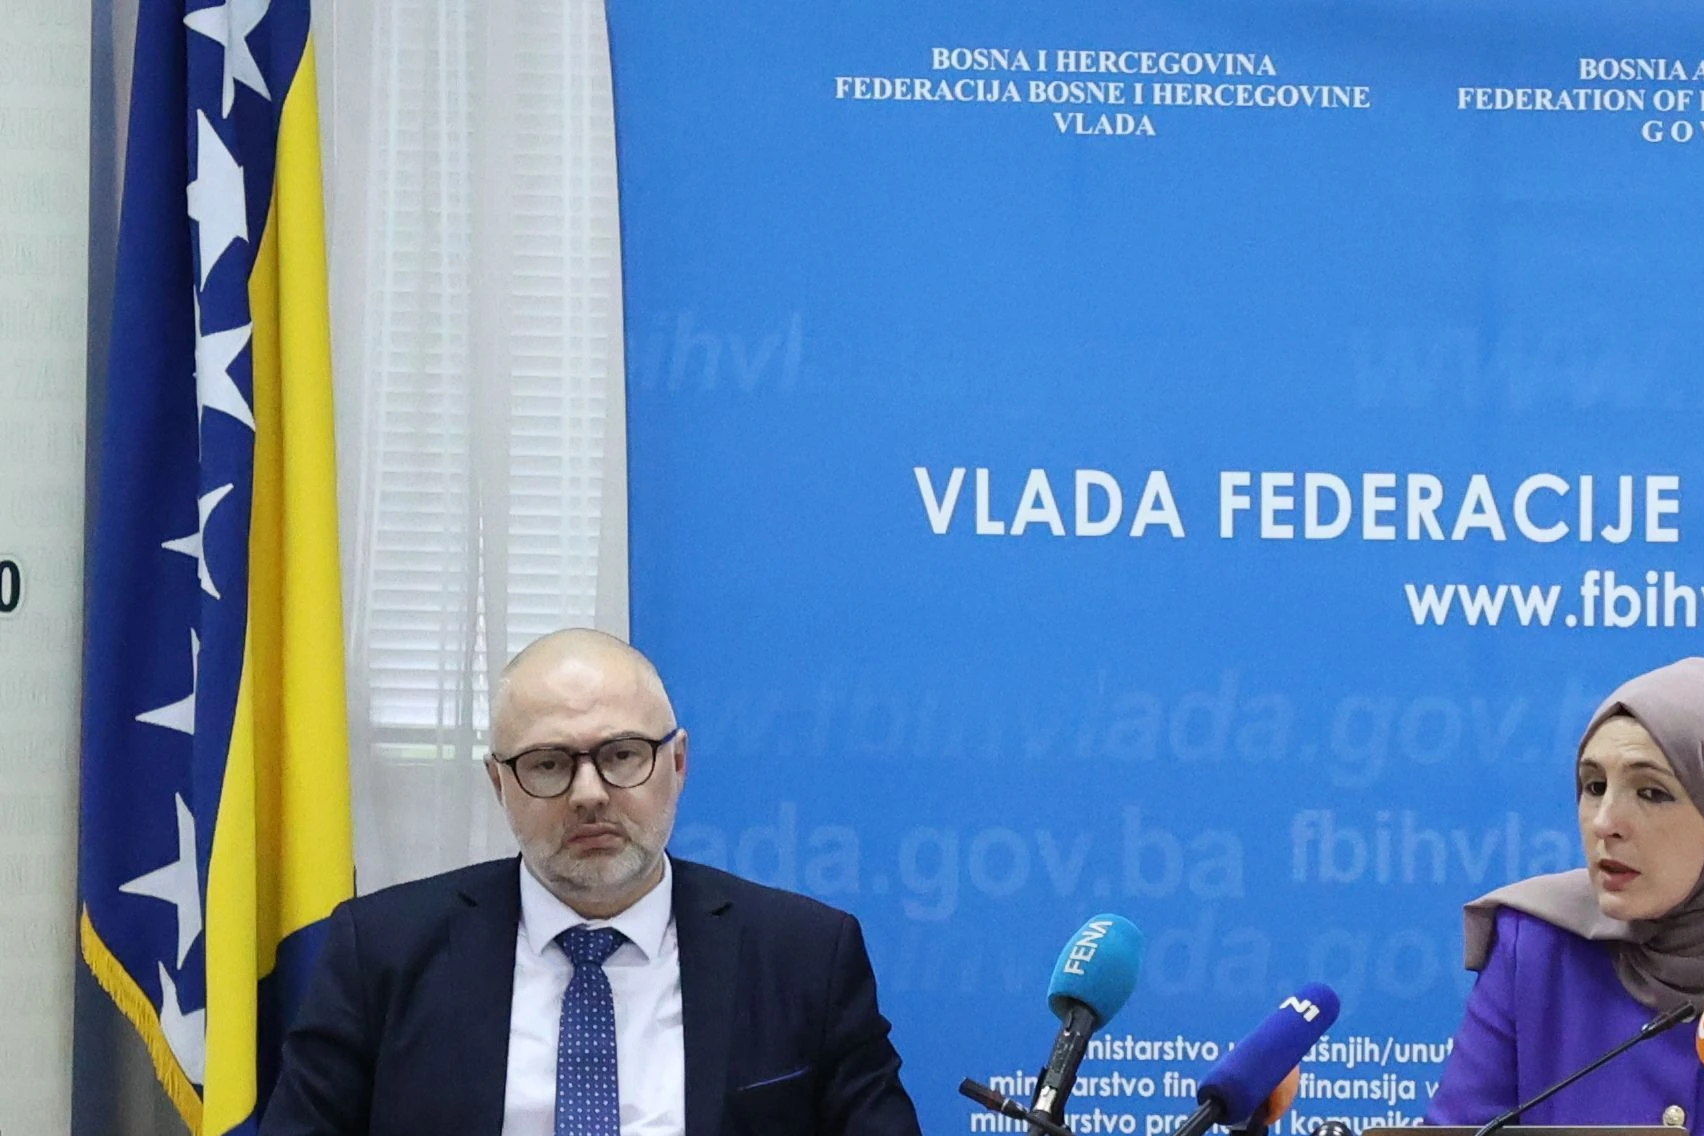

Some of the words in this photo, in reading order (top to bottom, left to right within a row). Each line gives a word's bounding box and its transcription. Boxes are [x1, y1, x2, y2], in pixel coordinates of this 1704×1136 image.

[933, 48, 1030, 71] BOSNA
[1038, 50, 1046, 71] I
[1057, 50, 1276, 75] HERCEGOVINA
[1580, 59, 1688, 80] BOSNIA
[836, 77, 1021, 101] FEDERACIJA
[1029, 81, 1124, 104] BOSNE
[1134, 83, 1143, 104] I
[1153, 83, 1370, 107] HERCEGOVINE
[1459, 88, 1645, 110] FEDERATION
[1653, 90, 1693, 111] OF
[1054, 113, 1155, 135] VLADA
[914, 467, 1185, 537] VLADA
[1221, 472, 1679, 543] FEDERACIJE
[1065, 920, 1112, 976] FENA
[1086, 1034, 1219, 1061] nistarstvo
[989, 1070, 1156, 1098] minarstvo
